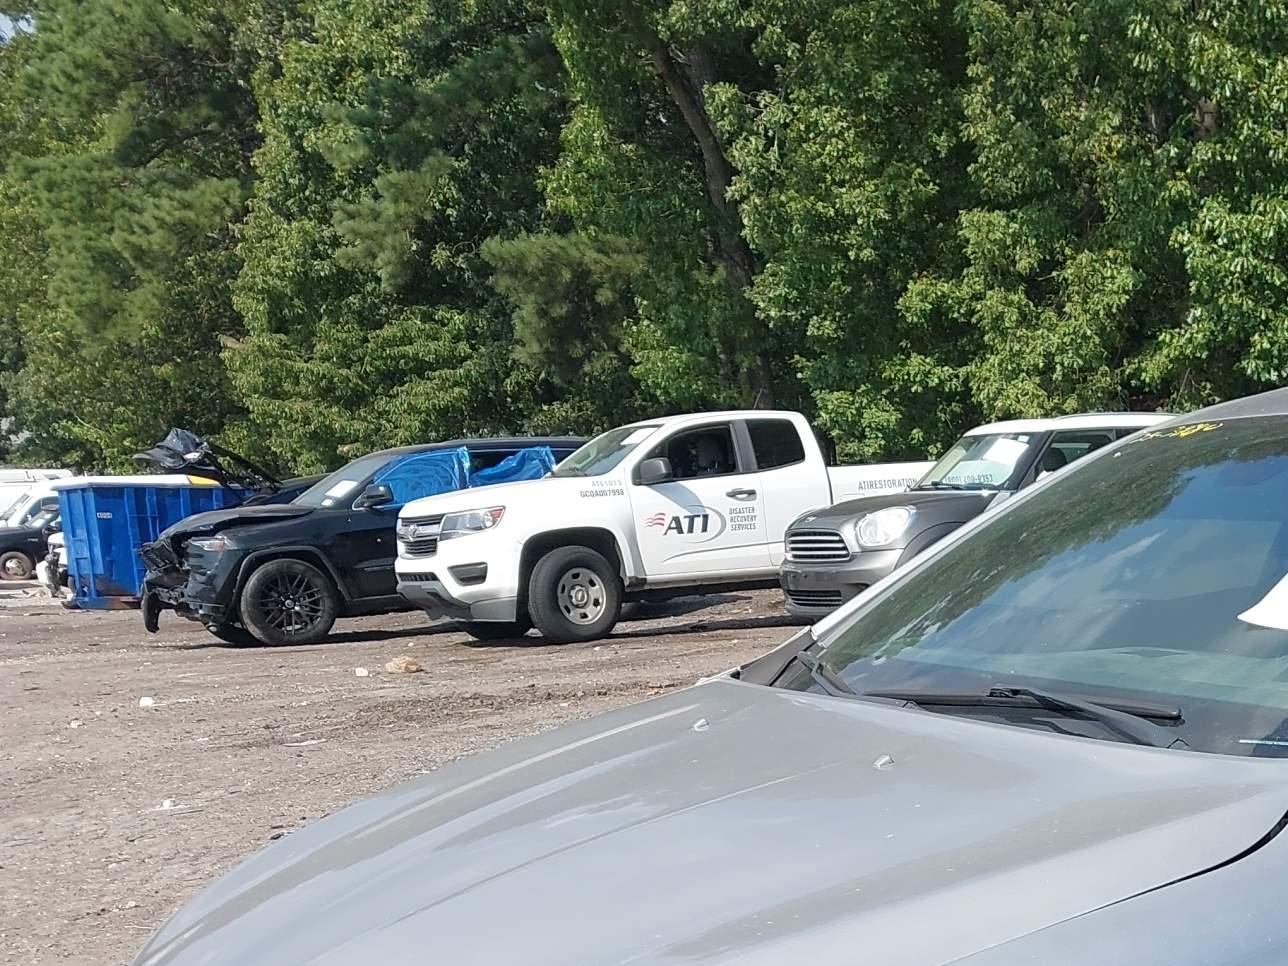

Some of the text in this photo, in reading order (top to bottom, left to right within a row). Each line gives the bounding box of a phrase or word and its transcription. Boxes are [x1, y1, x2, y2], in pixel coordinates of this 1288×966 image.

[729, 507, 755, 515] DISASTER
[730, 515, 757, 523] RECOVERY
[663, 513, 710, 536] ATI
[731, 523, 757, 532] SERVICES
